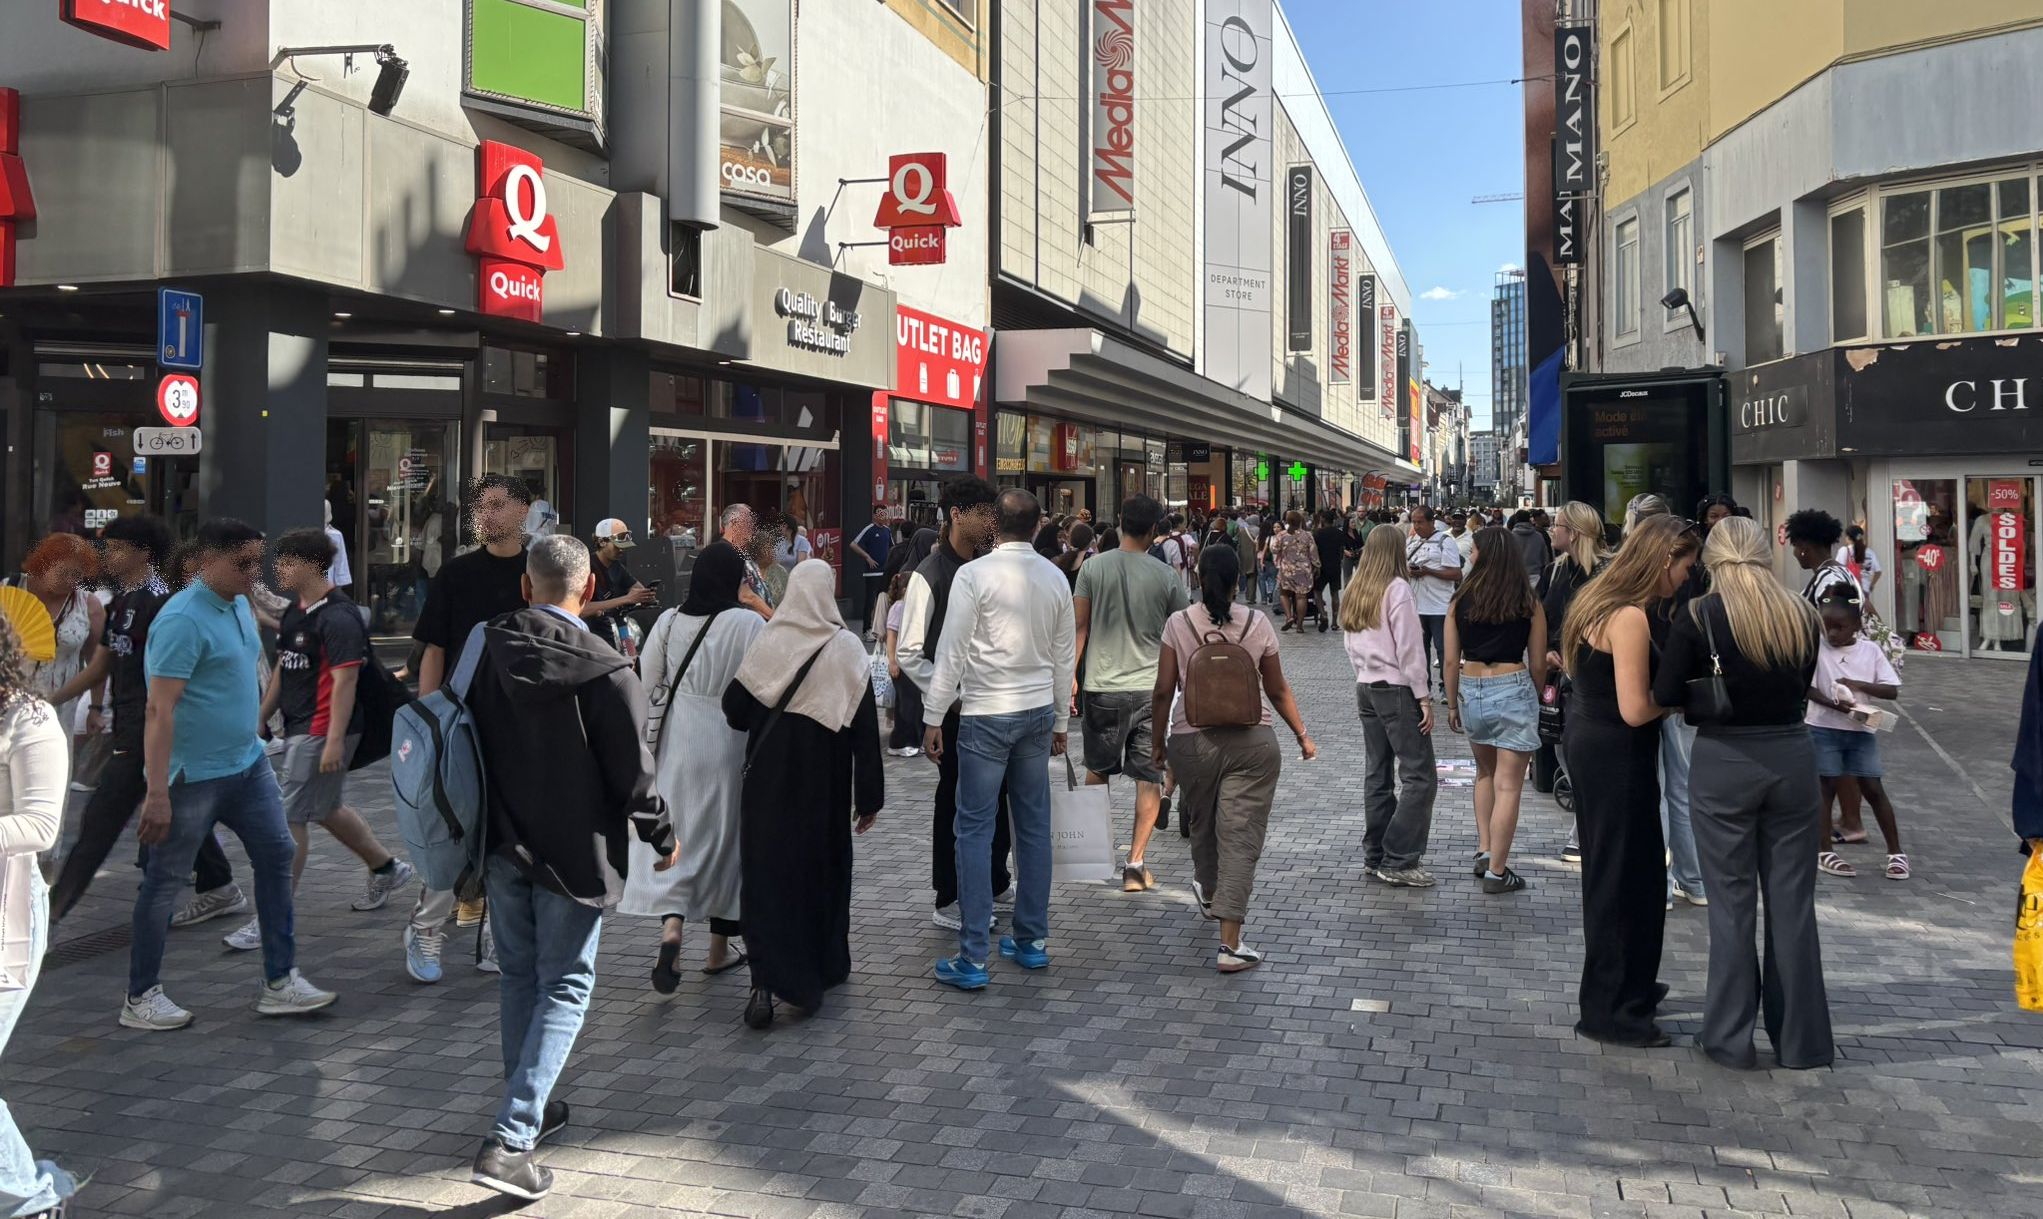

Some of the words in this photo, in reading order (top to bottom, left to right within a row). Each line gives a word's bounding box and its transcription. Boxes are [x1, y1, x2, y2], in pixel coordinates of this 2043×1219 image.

[1221, 15, 1258, 206] INNO
[1564, 34, 1583, 183] MANO
[722, 161, 772, 188] casa
[893, 162, 937, 216] Q
[506, 164, 551, 252] Q
[1293, 174, 1308, 217] INNO
[1560, 190, 1573, 258] MA
[892, 232, 939, 253] Quick
[490, 271, 541, 302] Quick
[1210, 273, 1267, 289] DEPARTMENT
[1225, 288, 1253, 301] STORE
[1362, 279, 1373, 310] INNO
[782, 287, 822, 322] Quality
[829, 301, 863, 329] Burger
[794, 319, 852, 353] Restaurant
[896, 313, 949, 357] UTLET
[952, 329, 982, 365] BAG
[172, 389, 182, 409] 3
[1619, 390, 1649, 398] JCDecaux
[1741, 394, 1790, 428] CHIC
[1944, 378, 2043, 412] CH
[82, 482, 97, 490] Rue
[1990, 488, 2019, 500] -50%
[1998, 512, 2017, 589] SOLDES
[1057, 831, 1085, 840] JOHN
